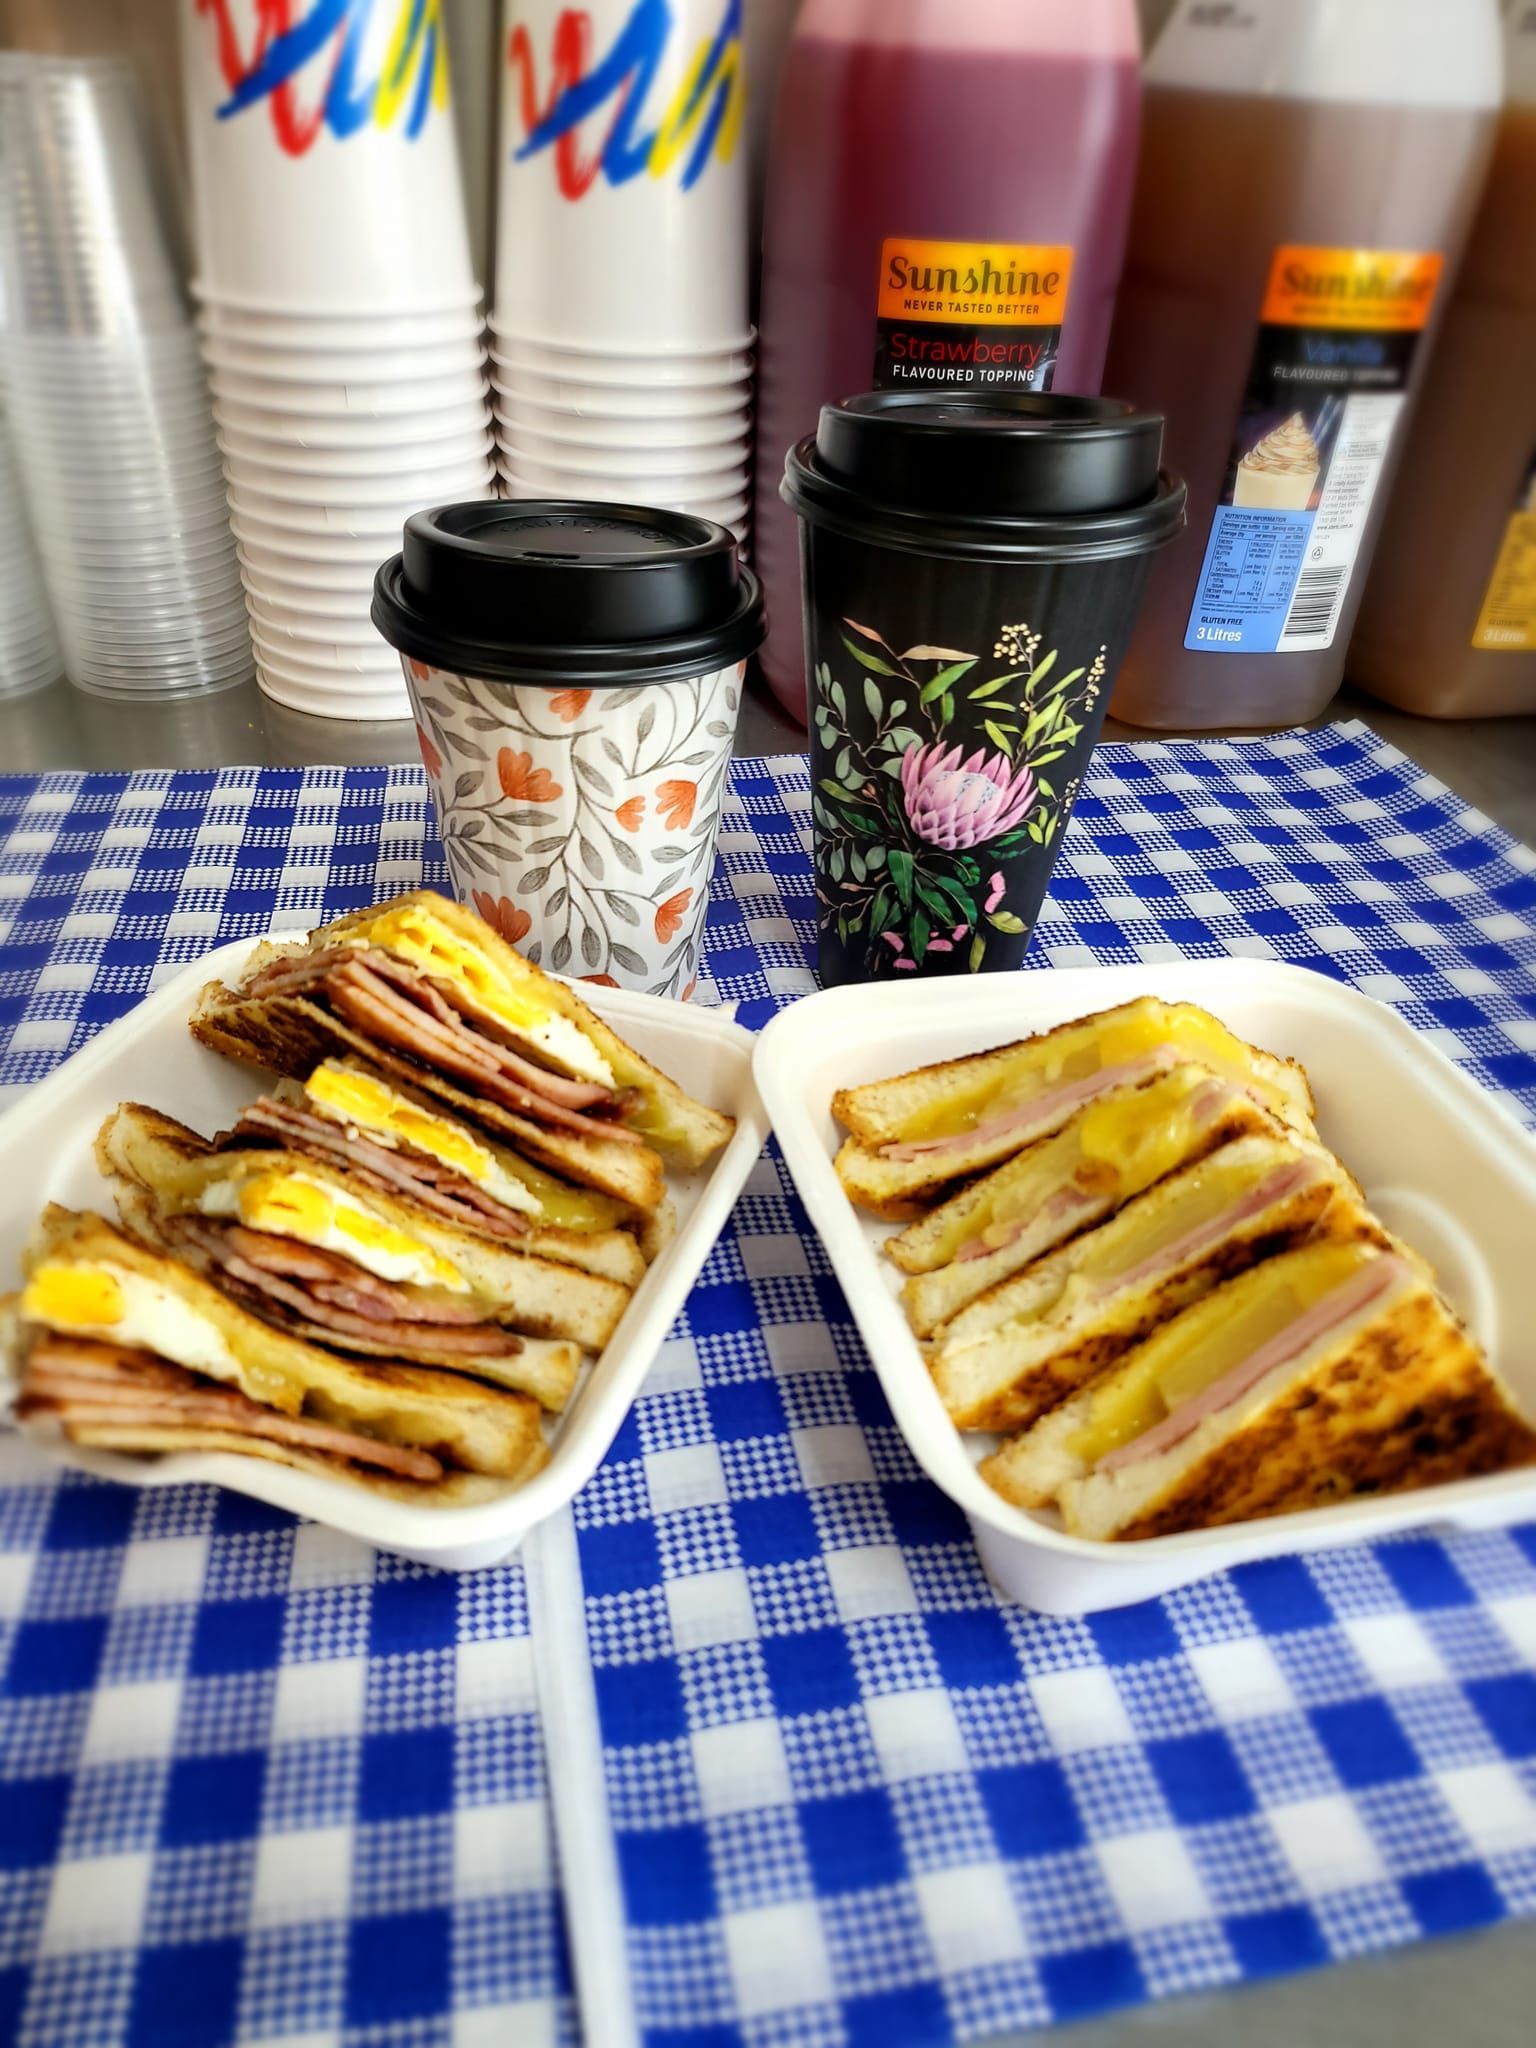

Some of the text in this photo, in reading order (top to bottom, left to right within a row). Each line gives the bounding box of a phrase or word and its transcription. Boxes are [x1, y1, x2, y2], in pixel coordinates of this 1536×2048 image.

[888, 256, 1060, 296] Sunshine
[904, 299, 1040, 315] NEVER TASTED BETTER
[890, 332, 1043, 369] Strawberry
[893, 364, 1035, 382] FLAVOURED TOPPING
[1273, 366, 1348, 381] FLAVOURED
[1201, 615, 1243, 626] GLUTEN FREE
[1197, 627, 1242, 642] 3 Litres
